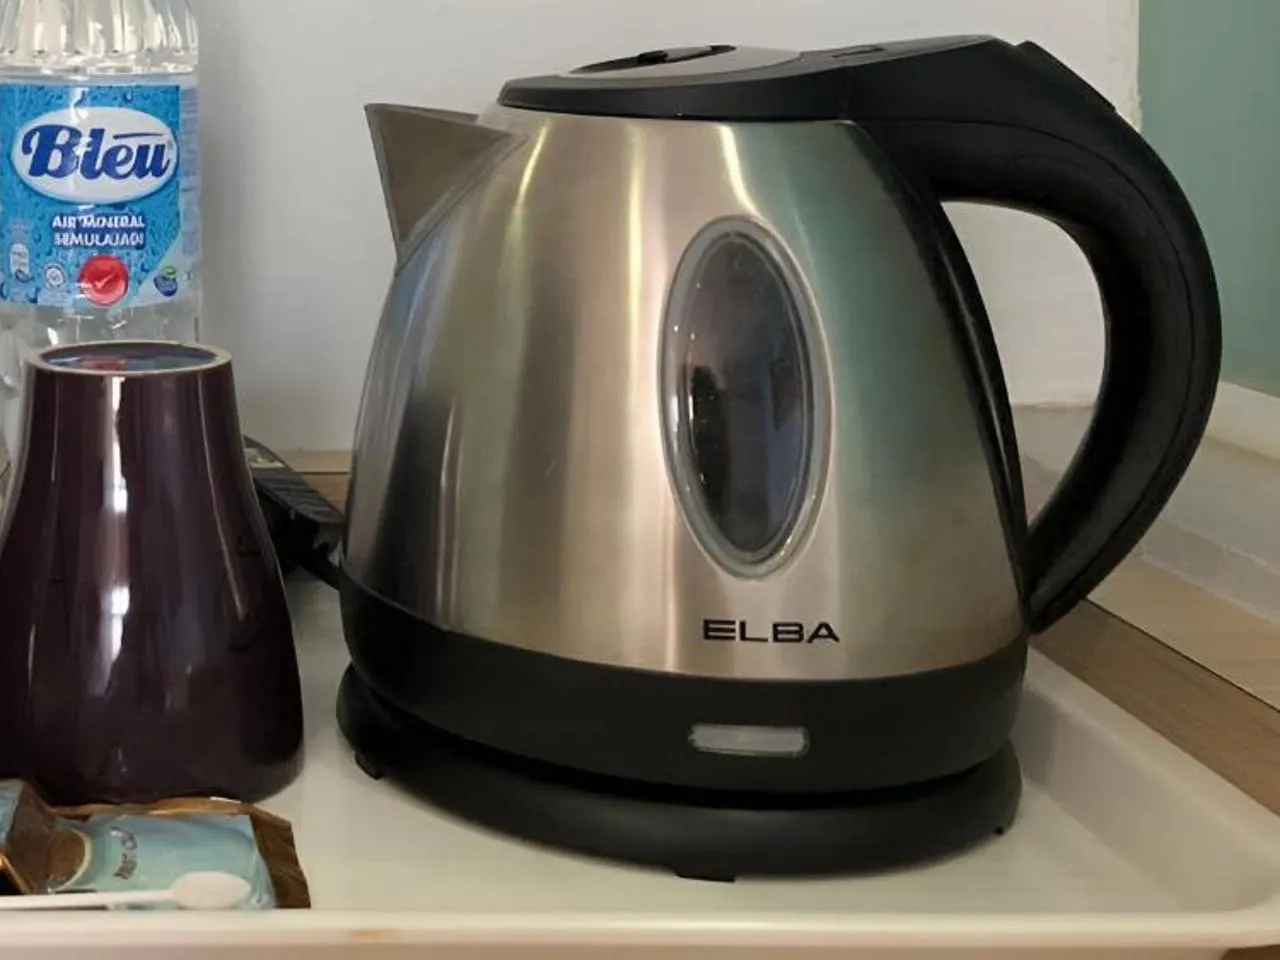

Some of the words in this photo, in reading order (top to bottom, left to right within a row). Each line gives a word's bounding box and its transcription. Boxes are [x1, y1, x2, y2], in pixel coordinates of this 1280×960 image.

[21, 123, 170, 180] Bleu
[52, 214, 76, 229] AIR
[703, 618, 840, 644] ELBA
